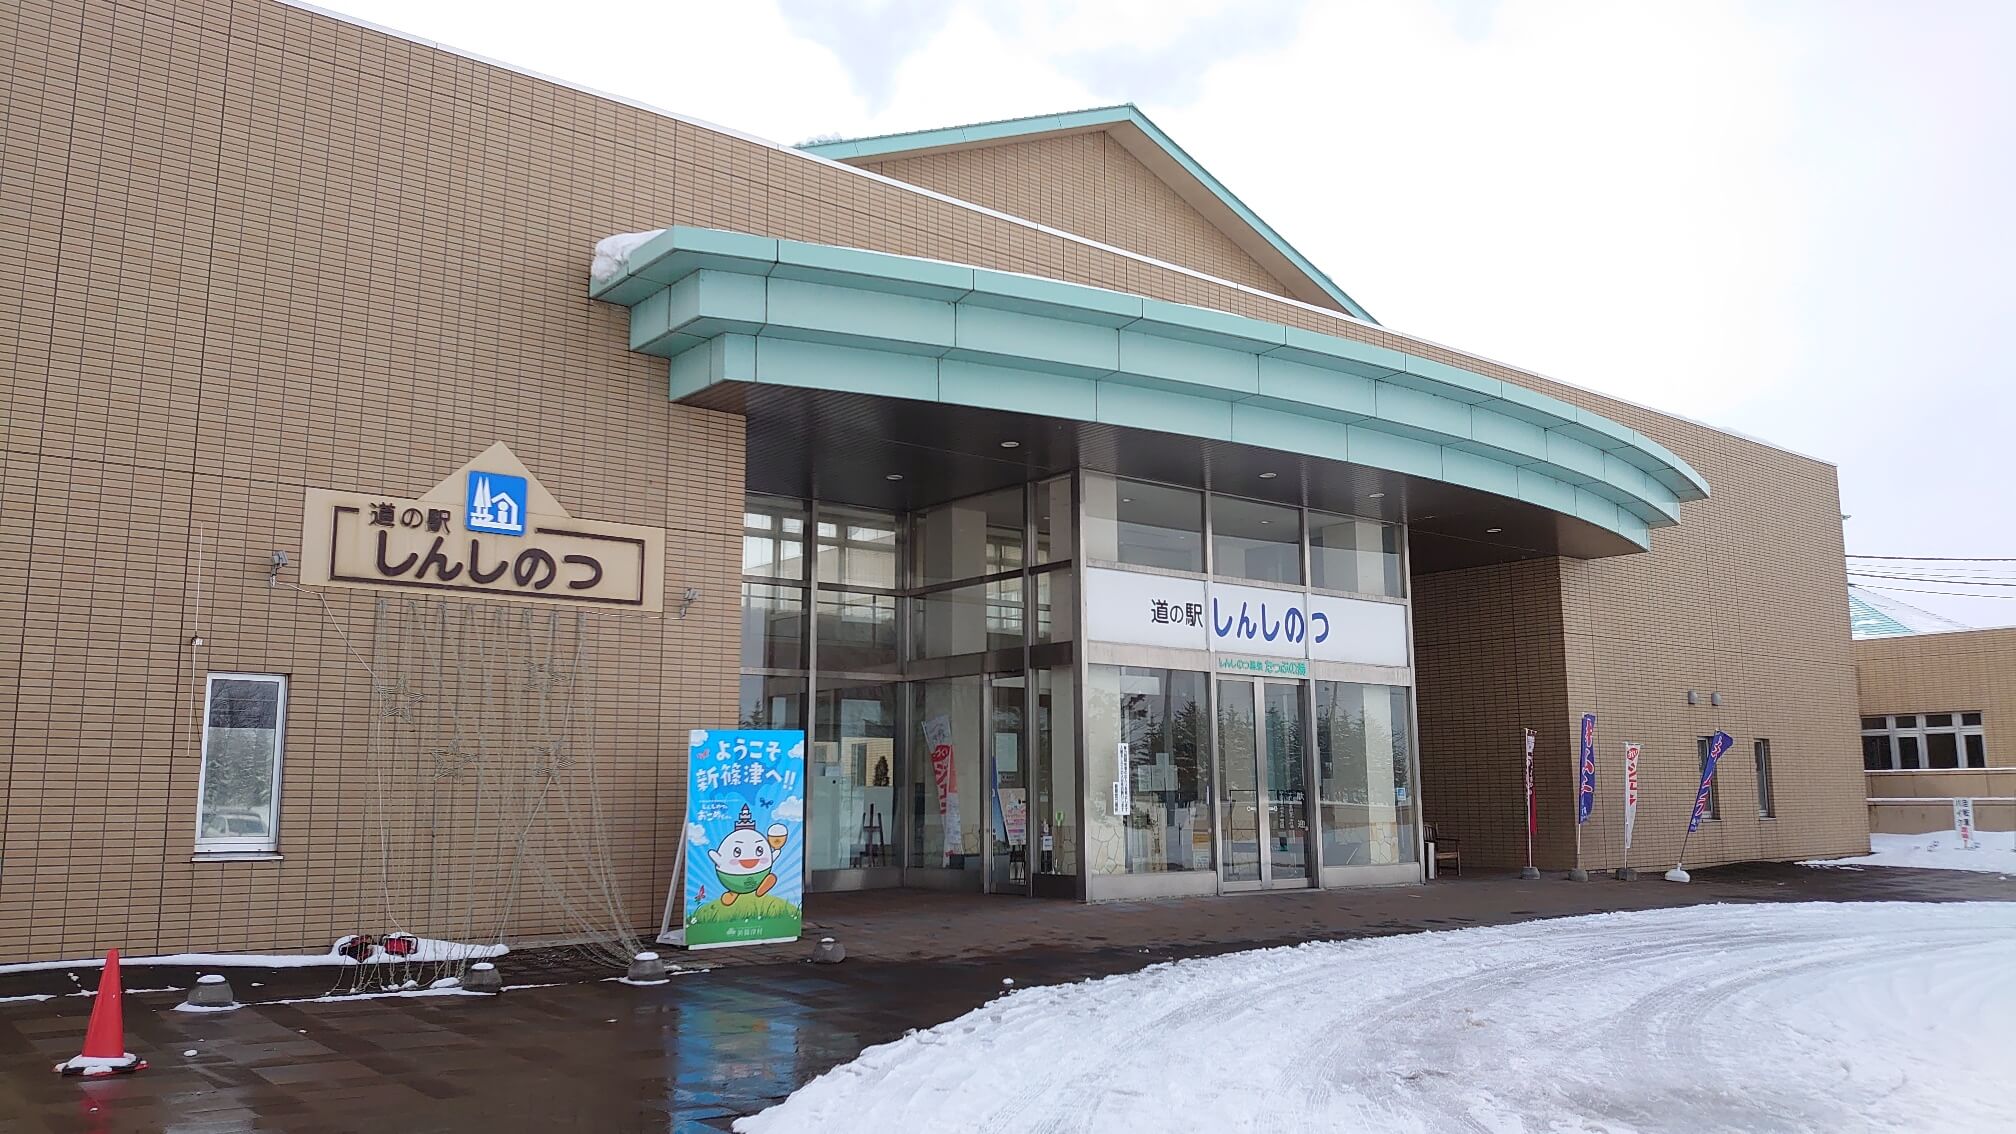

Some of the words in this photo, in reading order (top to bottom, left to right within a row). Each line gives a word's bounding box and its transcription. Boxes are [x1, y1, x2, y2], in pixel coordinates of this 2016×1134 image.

[368, 502, 451, 535] 道の駅
[377, 530, 603, 589] しんしのつ
[1150, 599, 1203, 628] 道の駅
[1213, 597, 1329, 644] しんしのつ
[716, 738, 781, 761] ようこそ
